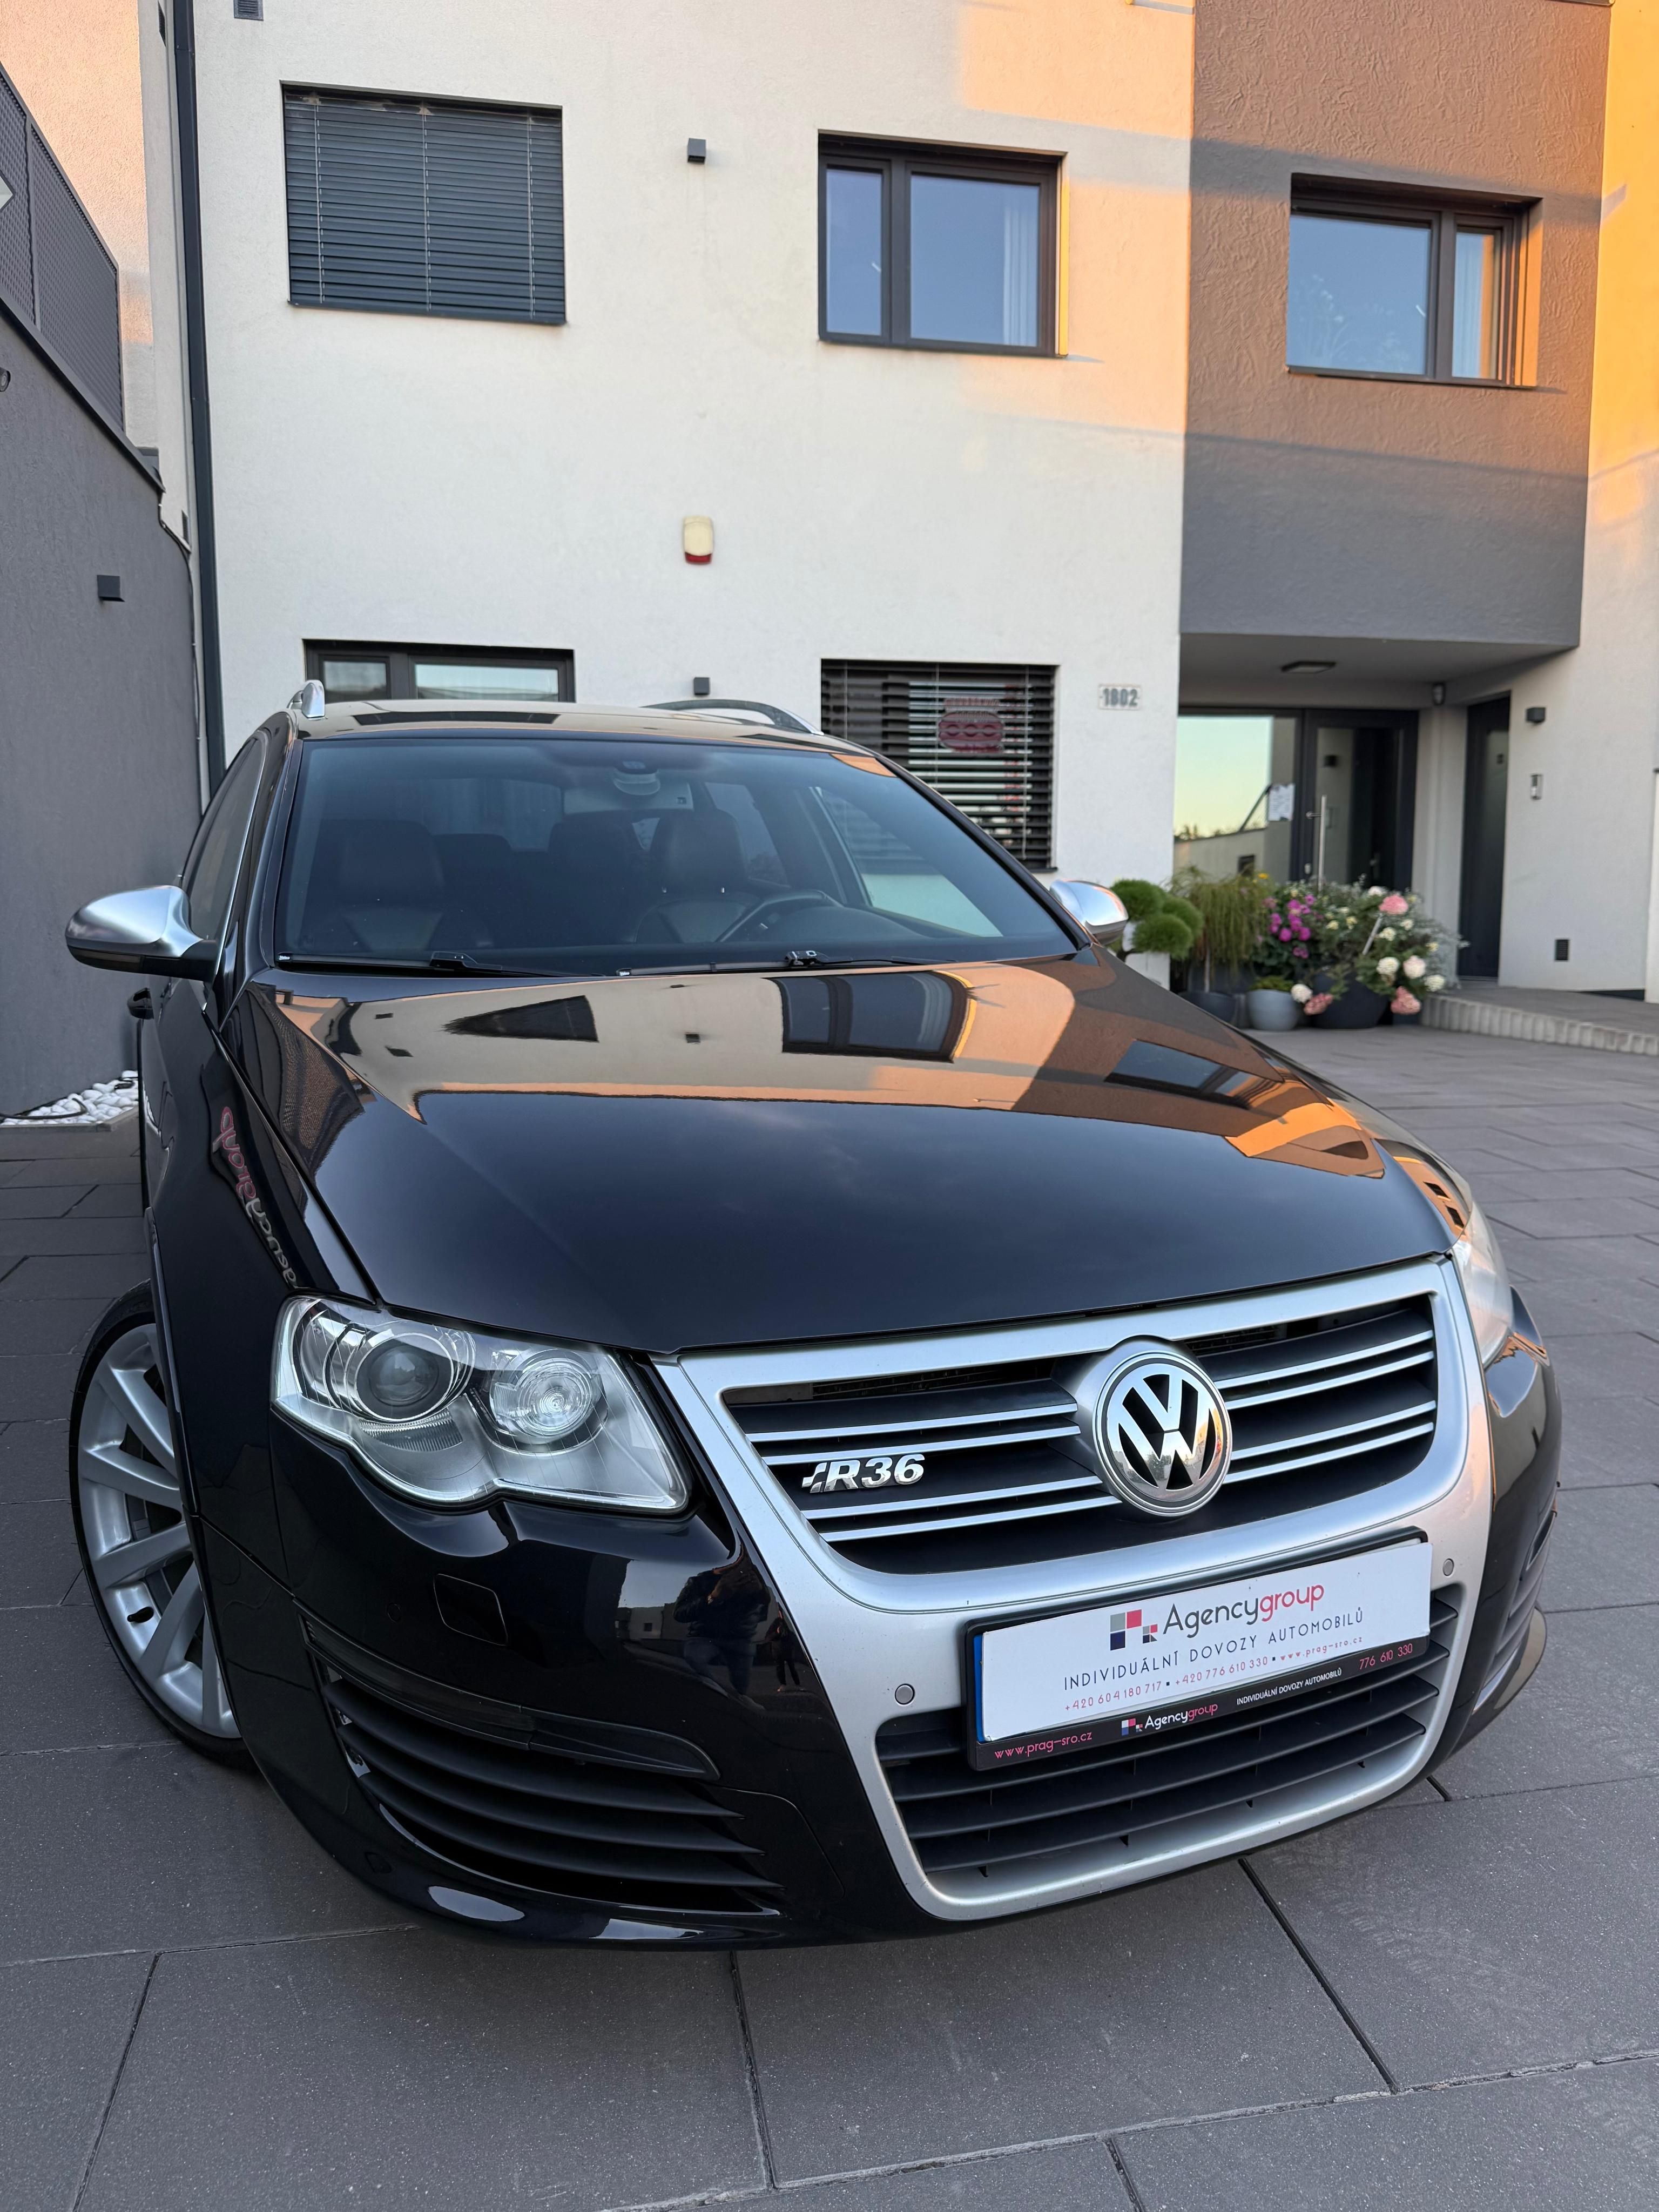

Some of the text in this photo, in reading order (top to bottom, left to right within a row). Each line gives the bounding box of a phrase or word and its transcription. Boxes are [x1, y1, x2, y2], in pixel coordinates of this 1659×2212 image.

[1102, 687, 1138, 707] 1802
[1107, 1363, 1219, 1492] VW
[823, 1454, 925, 1492] R36
[1064, 1607, 1363, 1690] INDIVIDUÁLNÍ DOVOZY AUTOMOBILŮ
[1163, 1584, 1325, 1638] Agencygroup
[994, 1643, 1413, 1759] www.prag-sro.cz Agencygroup INDIVIDUÁLNÍ DOVOZY AUTOMOBILŮ 776 610 330
[1065, 1636, 1363, 1711] +420 604 180 717 +420 776 610 330 www.prag-sro.cz
